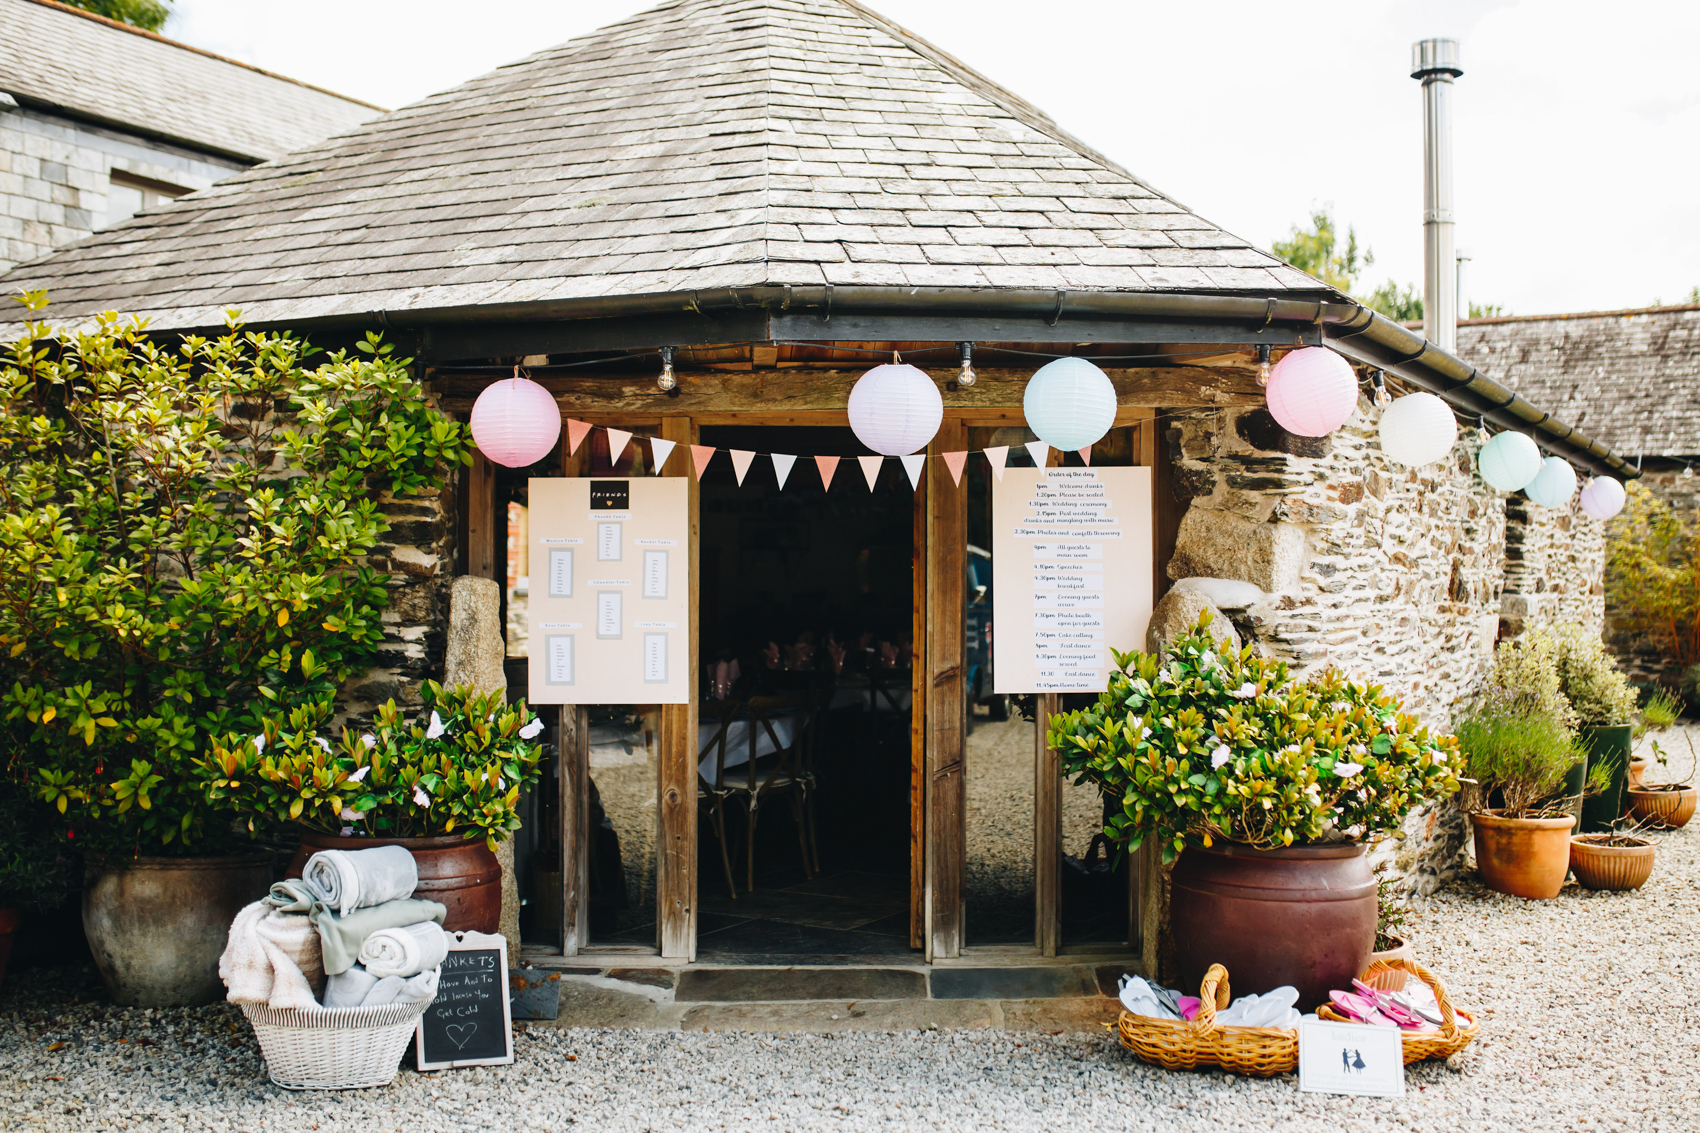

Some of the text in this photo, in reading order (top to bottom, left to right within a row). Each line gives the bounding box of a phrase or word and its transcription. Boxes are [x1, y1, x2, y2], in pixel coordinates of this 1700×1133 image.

[441, 956, 495, 969] ANKETS
[439, 975, 493, 989] Have And To
[475, 989, 489, 1000] You
[437, 1005, 478, 1019] Get Cold
[1331, 1031, 1367, 1042] Ladies
